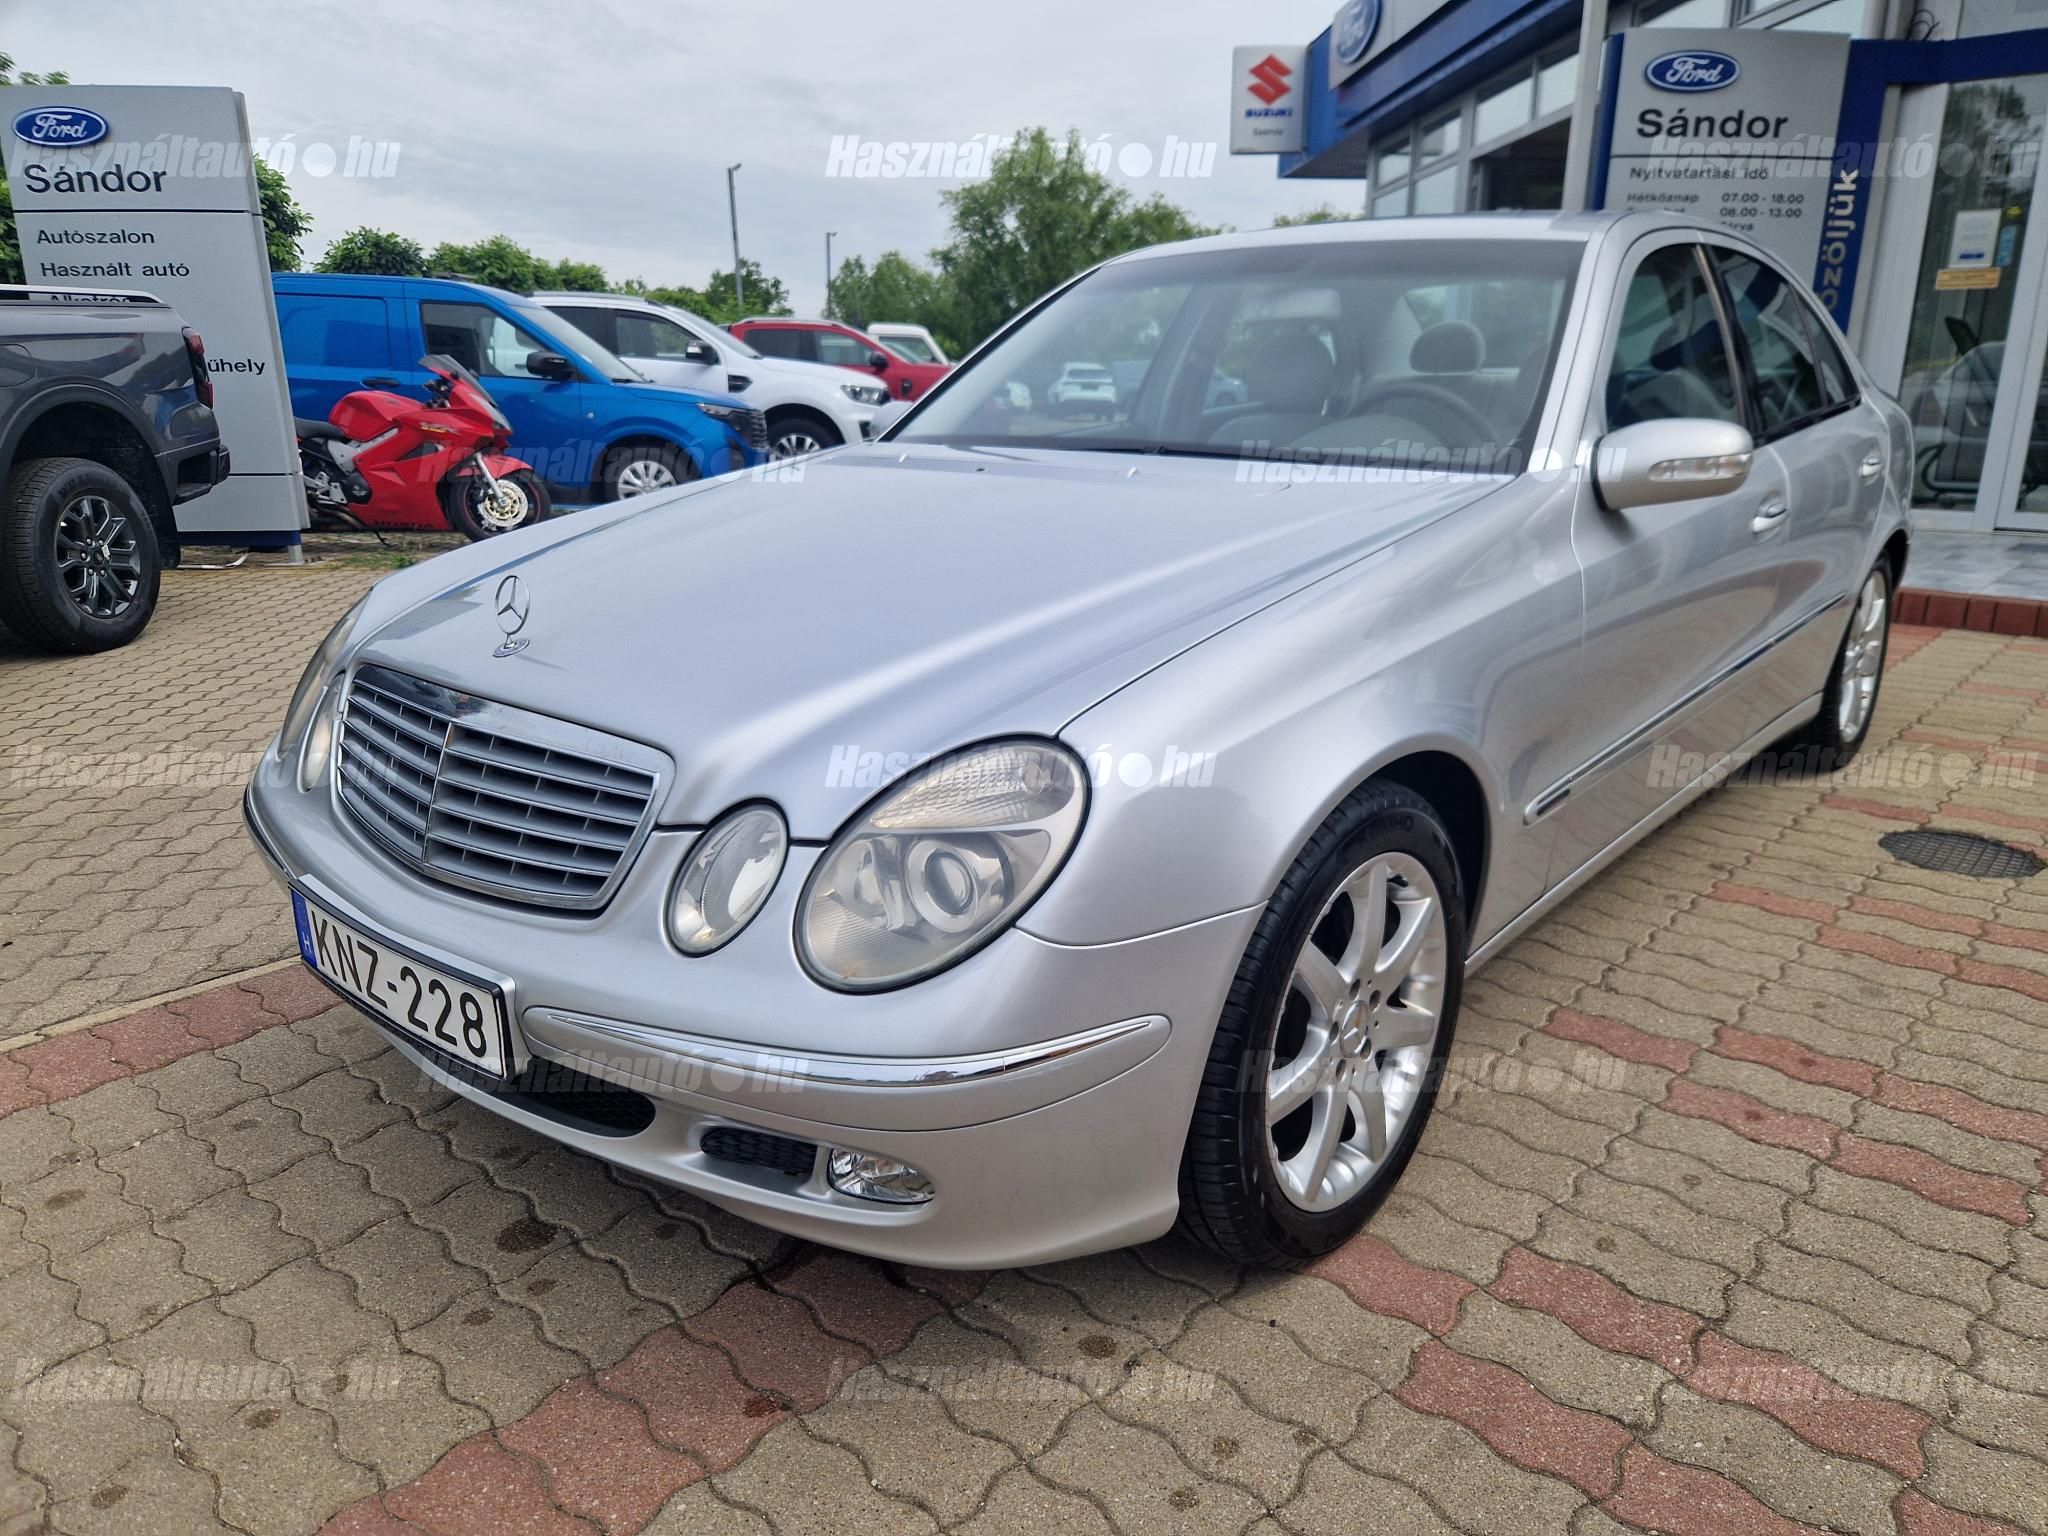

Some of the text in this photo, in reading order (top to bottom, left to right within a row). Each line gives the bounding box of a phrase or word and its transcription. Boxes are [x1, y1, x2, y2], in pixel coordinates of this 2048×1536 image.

[1665, 56, 1724, 84] Ford
[31, 113, 88, 138] Ford
[1245, 108, 1293, 118] SUZUKI
[1636, 108, 1788, 139] Sándor
[24, 163, 167, 193] Sándor
[37, 229, 155, 244] Autószalon
[41, 262, 190, 277] Használt autó
[312, 910, 487, 1059] KNZ-228
